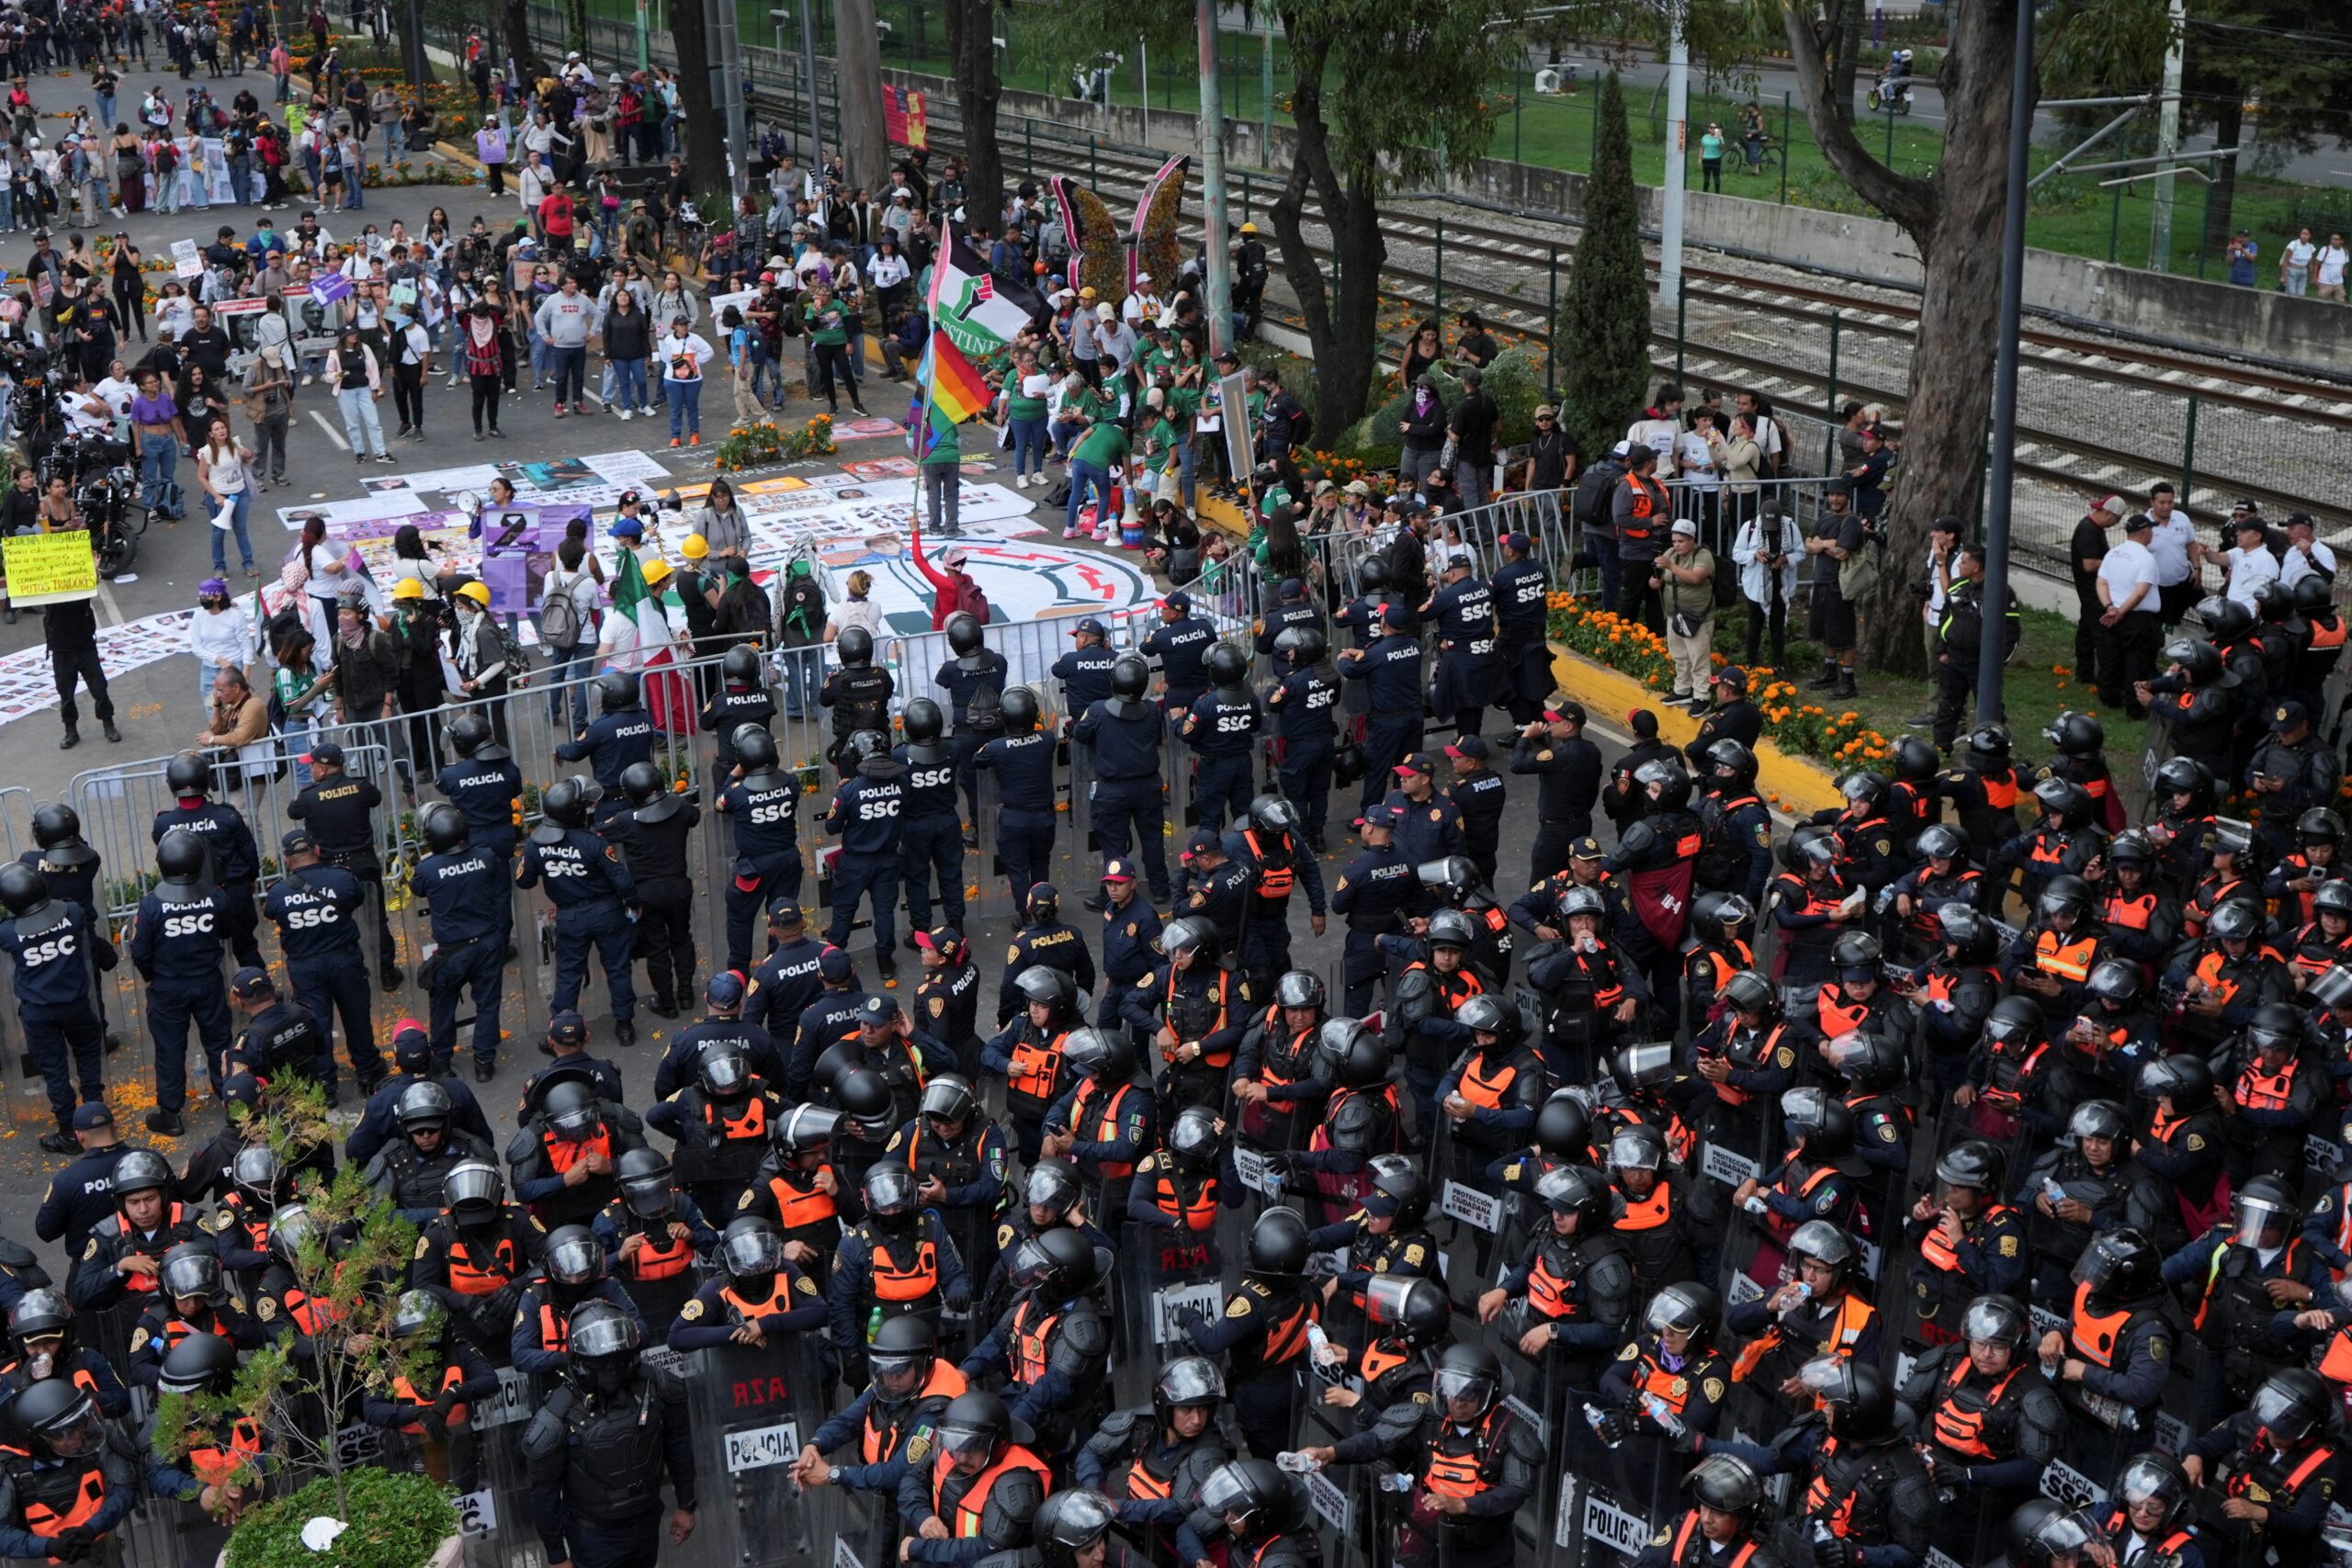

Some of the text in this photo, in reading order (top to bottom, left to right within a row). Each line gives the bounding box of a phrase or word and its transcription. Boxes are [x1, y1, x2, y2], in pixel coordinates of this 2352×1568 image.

[941, 319, 1001, 355] ESTINE
[1517, 582, 1545, 603] SSC
[1461, 601, 1492, 622] SSC
[1171, 630, 1206, 645] POLICÍA
[1306, 689, 1335, 709] SSC
[1217, 716, 1251, 732] SSC
[459, 772, 504, 788] POLICÍA
[911, 768, 952, 787] SSC
[859, 784, 902, 800] POLICÍA
[751, 800, 793, 824] SSC
[860, 799, 900, 820] SSC
[538, 846, 582, 860] POLICÍA
[438, 858, 486, 879] POLICÍA
[545, 861, 588, 877] SSC
[1371, 863, 1409, 880] POLICÍA
[164, 913, 214, 938] SSC
[287, 905, 339, 930] SSC
[23, 934, 76, 967] SSC
[778, 957, 820, 980] POLICÍ
[1515, 991, 1542, 1018] POLIC
[273, 1022, 306, 1044] SSC
[1711, 1156, 1750, 1179] CIUDADANA
[1712, 1149, 1752, 1171] PROTECCIÓN
[1245, 1173, 1258, 1183] SSC
[1717, 1168, 1732, 1179] SSC
[1452, 1195, 1491, 1217] CIUDADANA
[1453, 1187, 1493, 1210] PROTECCIÓN
[1457, 1205, 1472, 1218] SSC
[1167, 1297, 1215, 1327] POICIA
[730, 1431, 793, 1467] POICIA
[2051, 1462, 2095, 1498] POLICÍA
[1316, 1497, 1328, 1511] SSC
